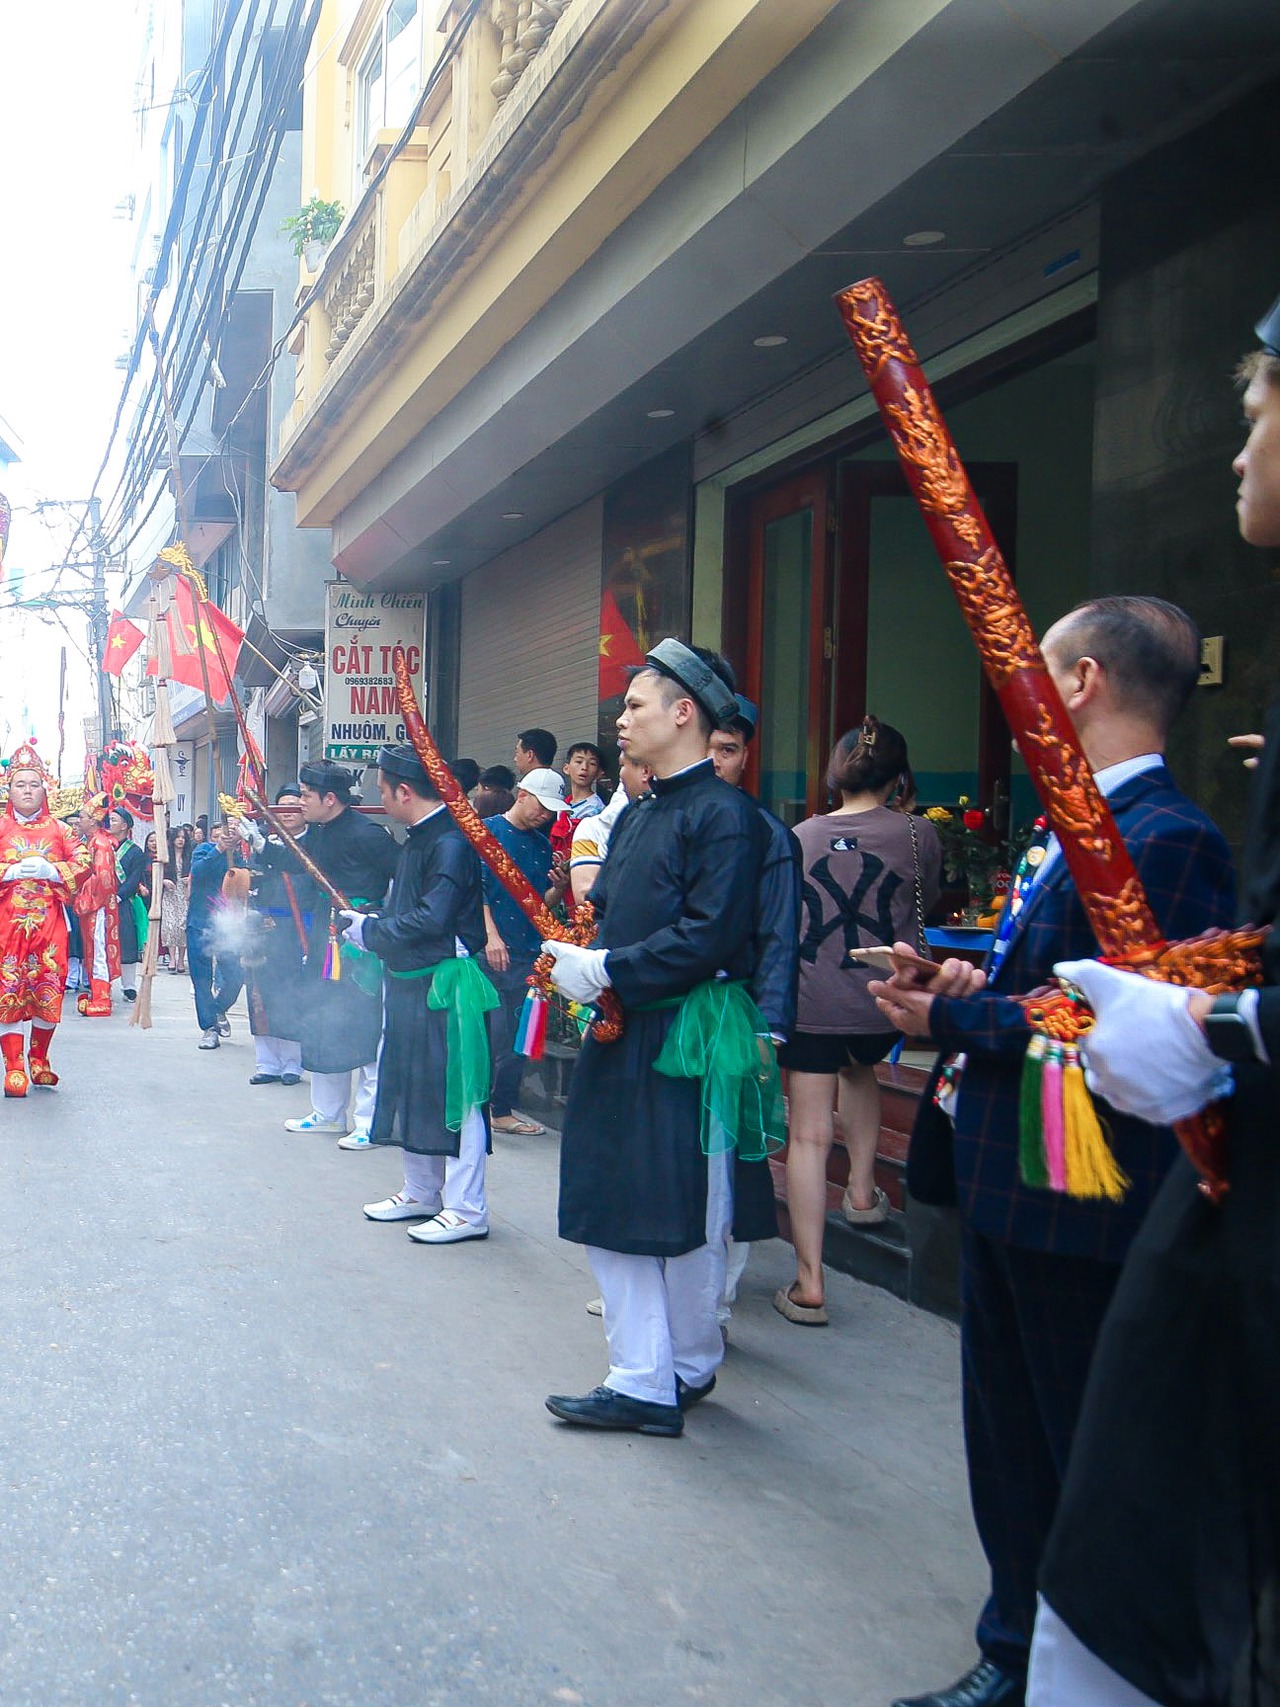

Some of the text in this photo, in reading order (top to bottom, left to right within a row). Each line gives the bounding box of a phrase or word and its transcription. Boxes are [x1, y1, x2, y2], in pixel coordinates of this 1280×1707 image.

[332, 592, 375, 610] Minh
[332, 635, 420, 675] CẮT TÓC
[350, 687, 401, 715] NAM
[330, 746, 357, 760] LẤY
